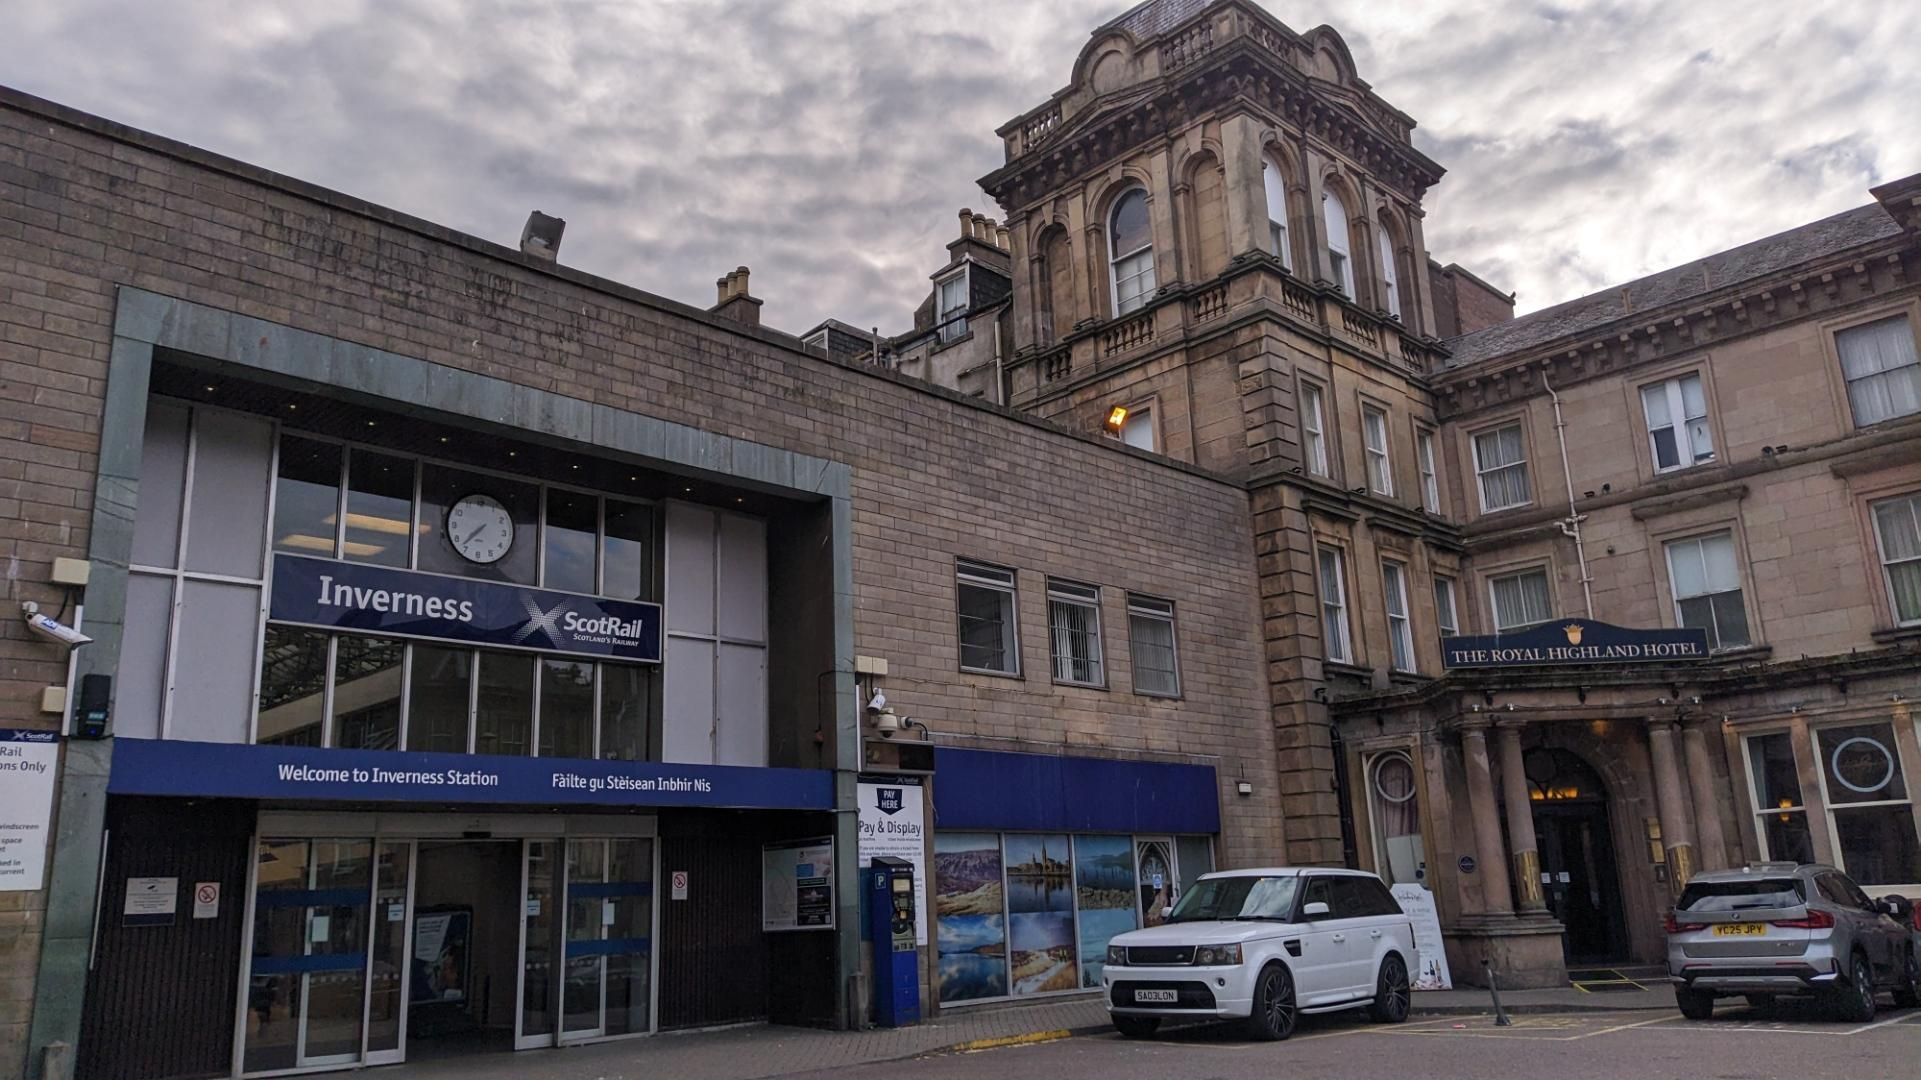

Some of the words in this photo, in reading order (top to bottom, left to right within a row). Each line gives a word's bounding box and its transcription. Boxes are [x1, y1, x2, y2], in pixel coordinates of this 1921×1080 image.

[488, 549, 493, 557] 5
[317, 575, 473, 622] Inverness
[563, 611, 643, 639] ScotRail
[612, 638, 639, 647] RAILWAY
[1451, 649, 1489, 663] THE
[1491, 647, 1545, 662] ROYAL
[1547, 644, 1640, 660] HIGHLAND
[1643, 642, 1702, 657] HOTEL
[0, 746, 22, 757] Rail
[20, 760, 47, 775] Only
[278, 764, 349, 782] Welcome
[352, 767, 369, 782] to
[372, 767, 444, 785] Inverness
[447, 769, 498, 786] Station
[552, 773, 587, 788] Fàilte
[589, 777, 604, 792] gu
[607, 775, 655, 791] Stèisean
[658, 776, 692, 792] Inbhir
[694, 778, 711, 792] Nis
[883, 790, 895, 799] PAY
[881, 800, 898, 809] HERE
[859, 820, 875, 836] Pay
[877, 820, 885, 833] &
[887, 821, 921, 837] Display
[1717, 925, 1741, 935] YC25
[1743, 923, 1763, 934] JPY
